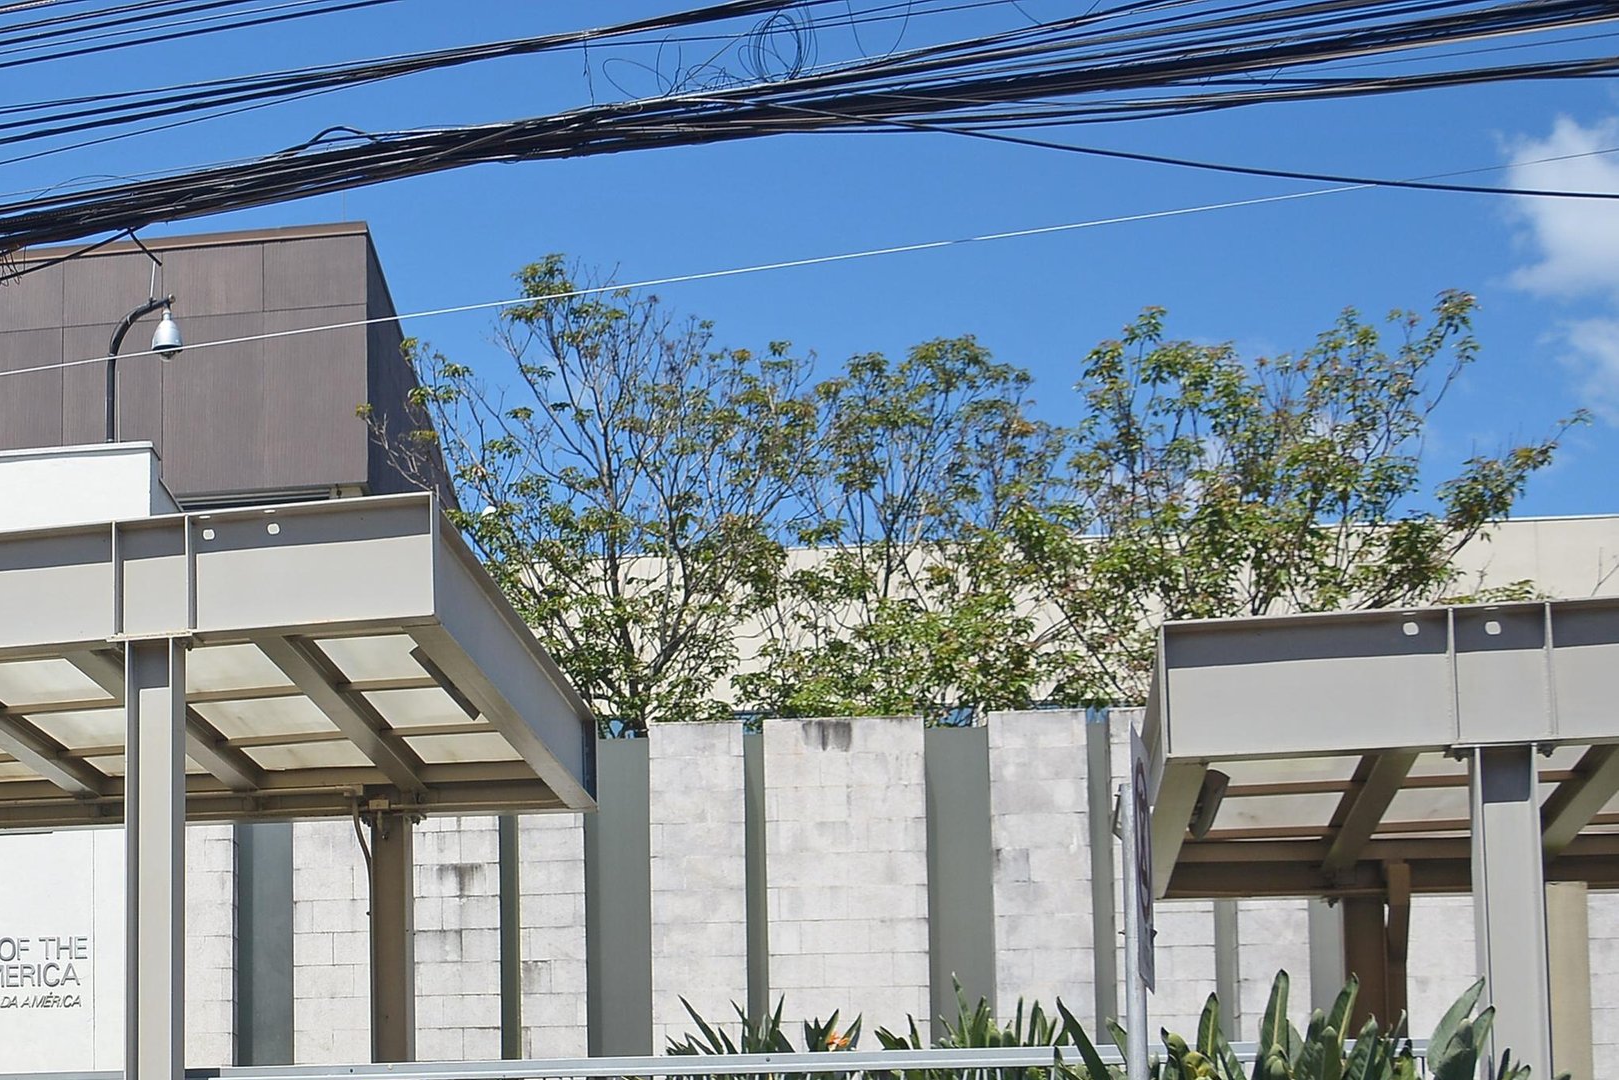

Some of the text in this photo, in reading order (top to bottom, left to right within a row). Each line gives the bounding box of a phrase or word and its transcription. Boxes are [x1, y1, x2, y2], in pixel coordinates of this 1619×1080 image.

[39, 936, 88, 960] THE
[0, 995, 18, 1008] DA
[21, 992, 82, 1008] AMÉRICA
